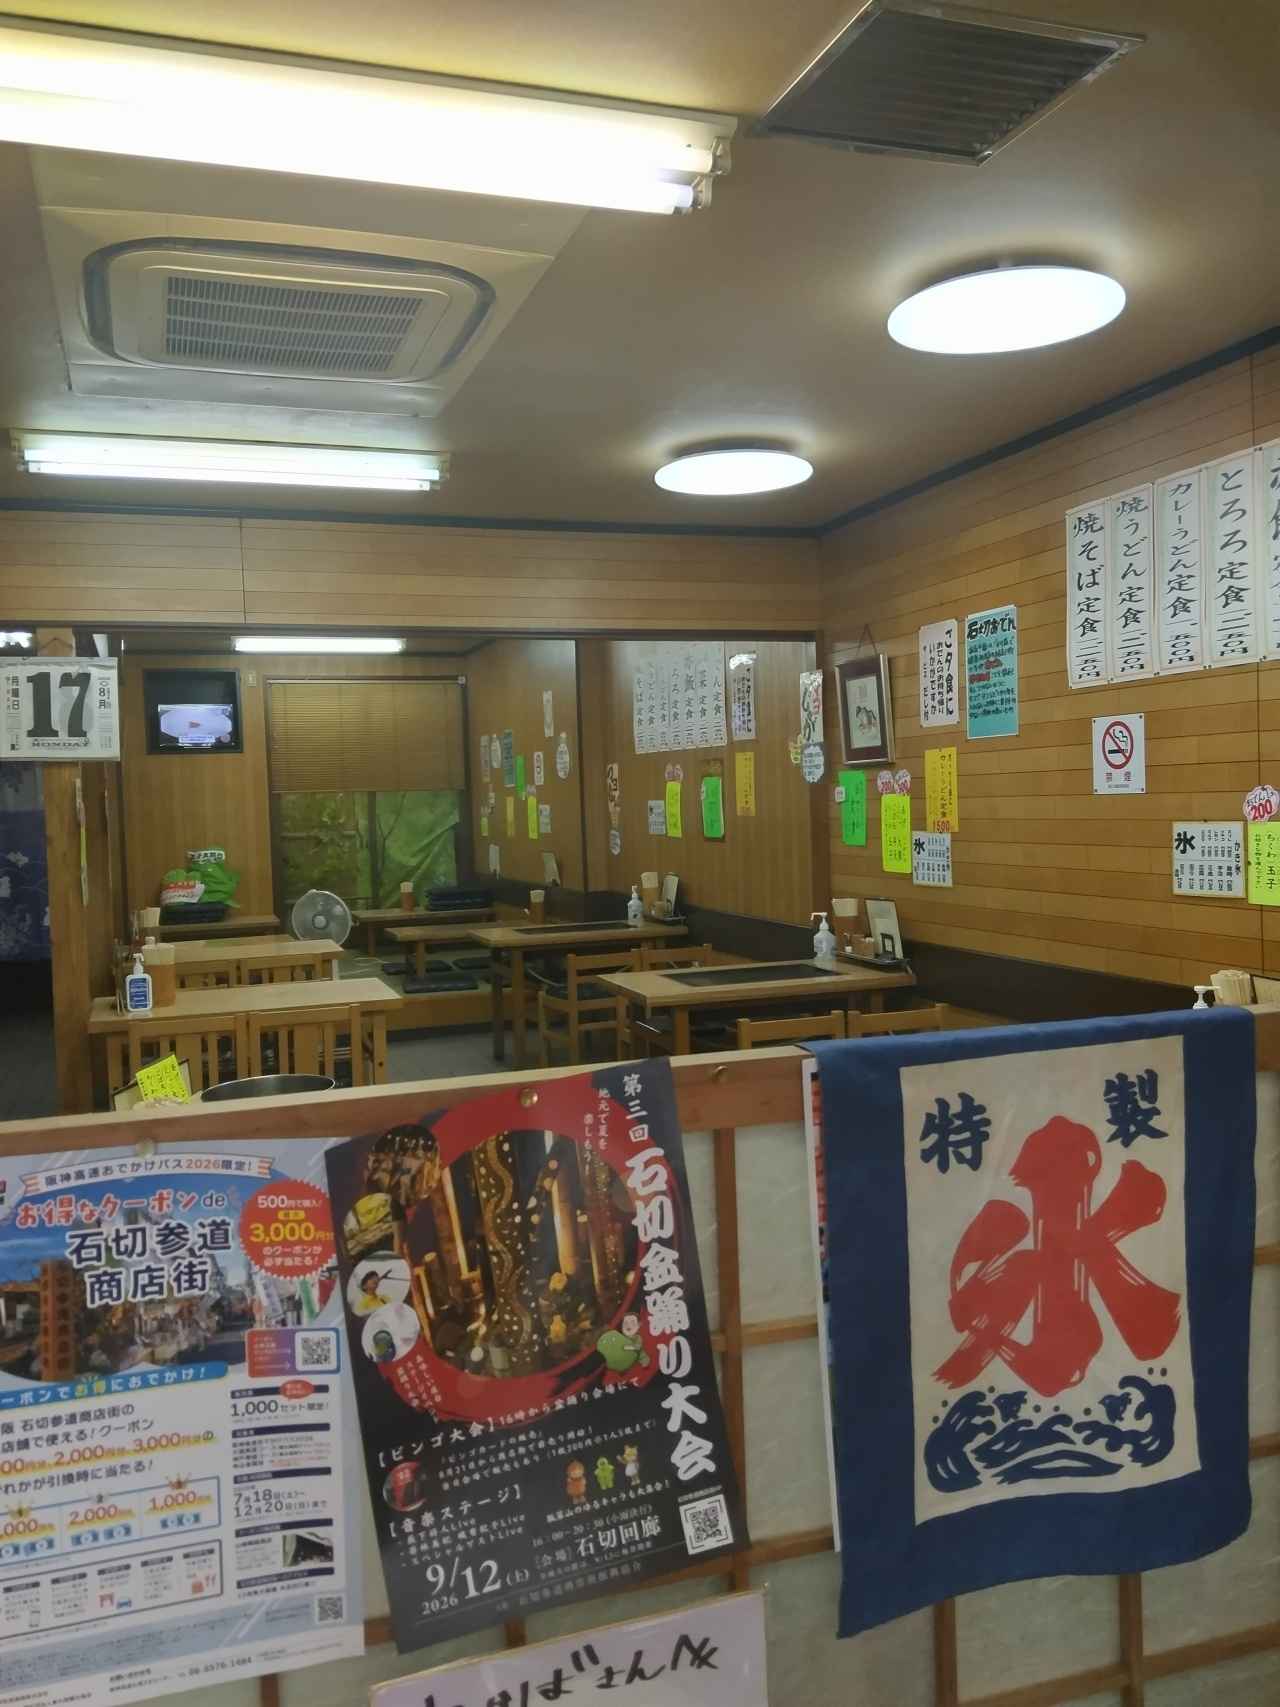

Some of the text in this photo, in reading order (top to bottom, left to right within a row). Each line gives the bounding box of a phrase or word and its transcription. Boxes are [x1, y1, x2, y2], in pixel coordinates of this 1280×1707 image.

[26, 671, 91, 738] 17
[1250, 799, 1274, 820] 200
[1174, 830, 1196, 855] 氷
[623, 1073, 649, 1143] 第三回
[918, 1068, 1169, 1175] 特 製
[16, 1189, 226, 1229] お得なクーポン de
[67, 1218, 232, 1266] 石切参道
[931, 1115, 1182, 1398] 氷
[86, 1259, 210, 1307] 商店街
[576, 1514, 663, 1557] 石切回廊
[425, 1555, 503, 1600] 9/12
[420, 1593, 460, 1616] 2026
